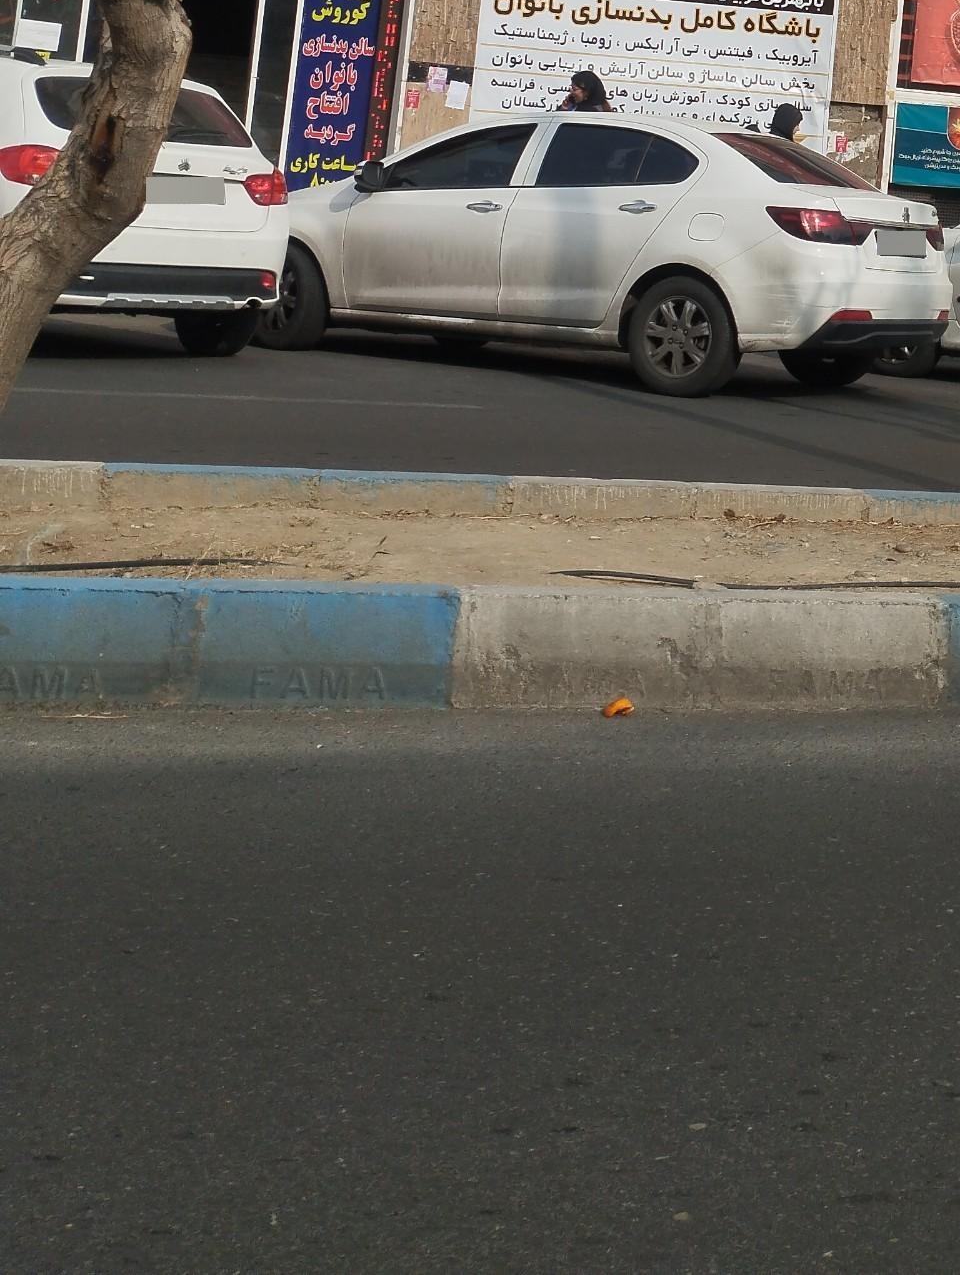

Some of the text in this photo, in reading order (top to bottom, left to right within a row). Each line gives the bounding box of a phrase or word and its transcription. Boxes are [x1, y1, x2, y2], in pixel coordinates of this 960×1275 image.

[679, 7, 737, 35] کامل
[743, 11, 822, 44] باشگاه
[493, 23, 570, 45] ژیمناستیک
[580, 32, 613, 50] زومبا
[302, 33, 376, 61] سالن بدنسازی
[625, 38, 664, 53] ایکس
[666, 37, 681, 55] آر
[682, 44, 700, 56] تی
[491, 51, 534, 71] بانوان
[765, 48, 819, 67] آیروبیک
[309, 61, 358, 92] بانوان
[599, 60, 646, 78] آرایش
[647, 66, 684, 80] سالن
[688, 71, 695, 83] و
[700, 66, 737, 84] ماساژ
[490, 77, 536, 93] فرانسه
[741, 74, 776, 88] سالن
[780, 75, 815, 93] بخش
[501, 95, 560, 113] زرگسالان
[632, 88, 659, 103] زبان
[662, 90, 707, 105] آموزش
[716, 94, 751, 110] کودک
[306, 92, 350, 120] افتتاح
[304, 123, 356, 147] گردید
[290, 153, 321, 174] کاری
[249, 666, 388, 701] FAMA
